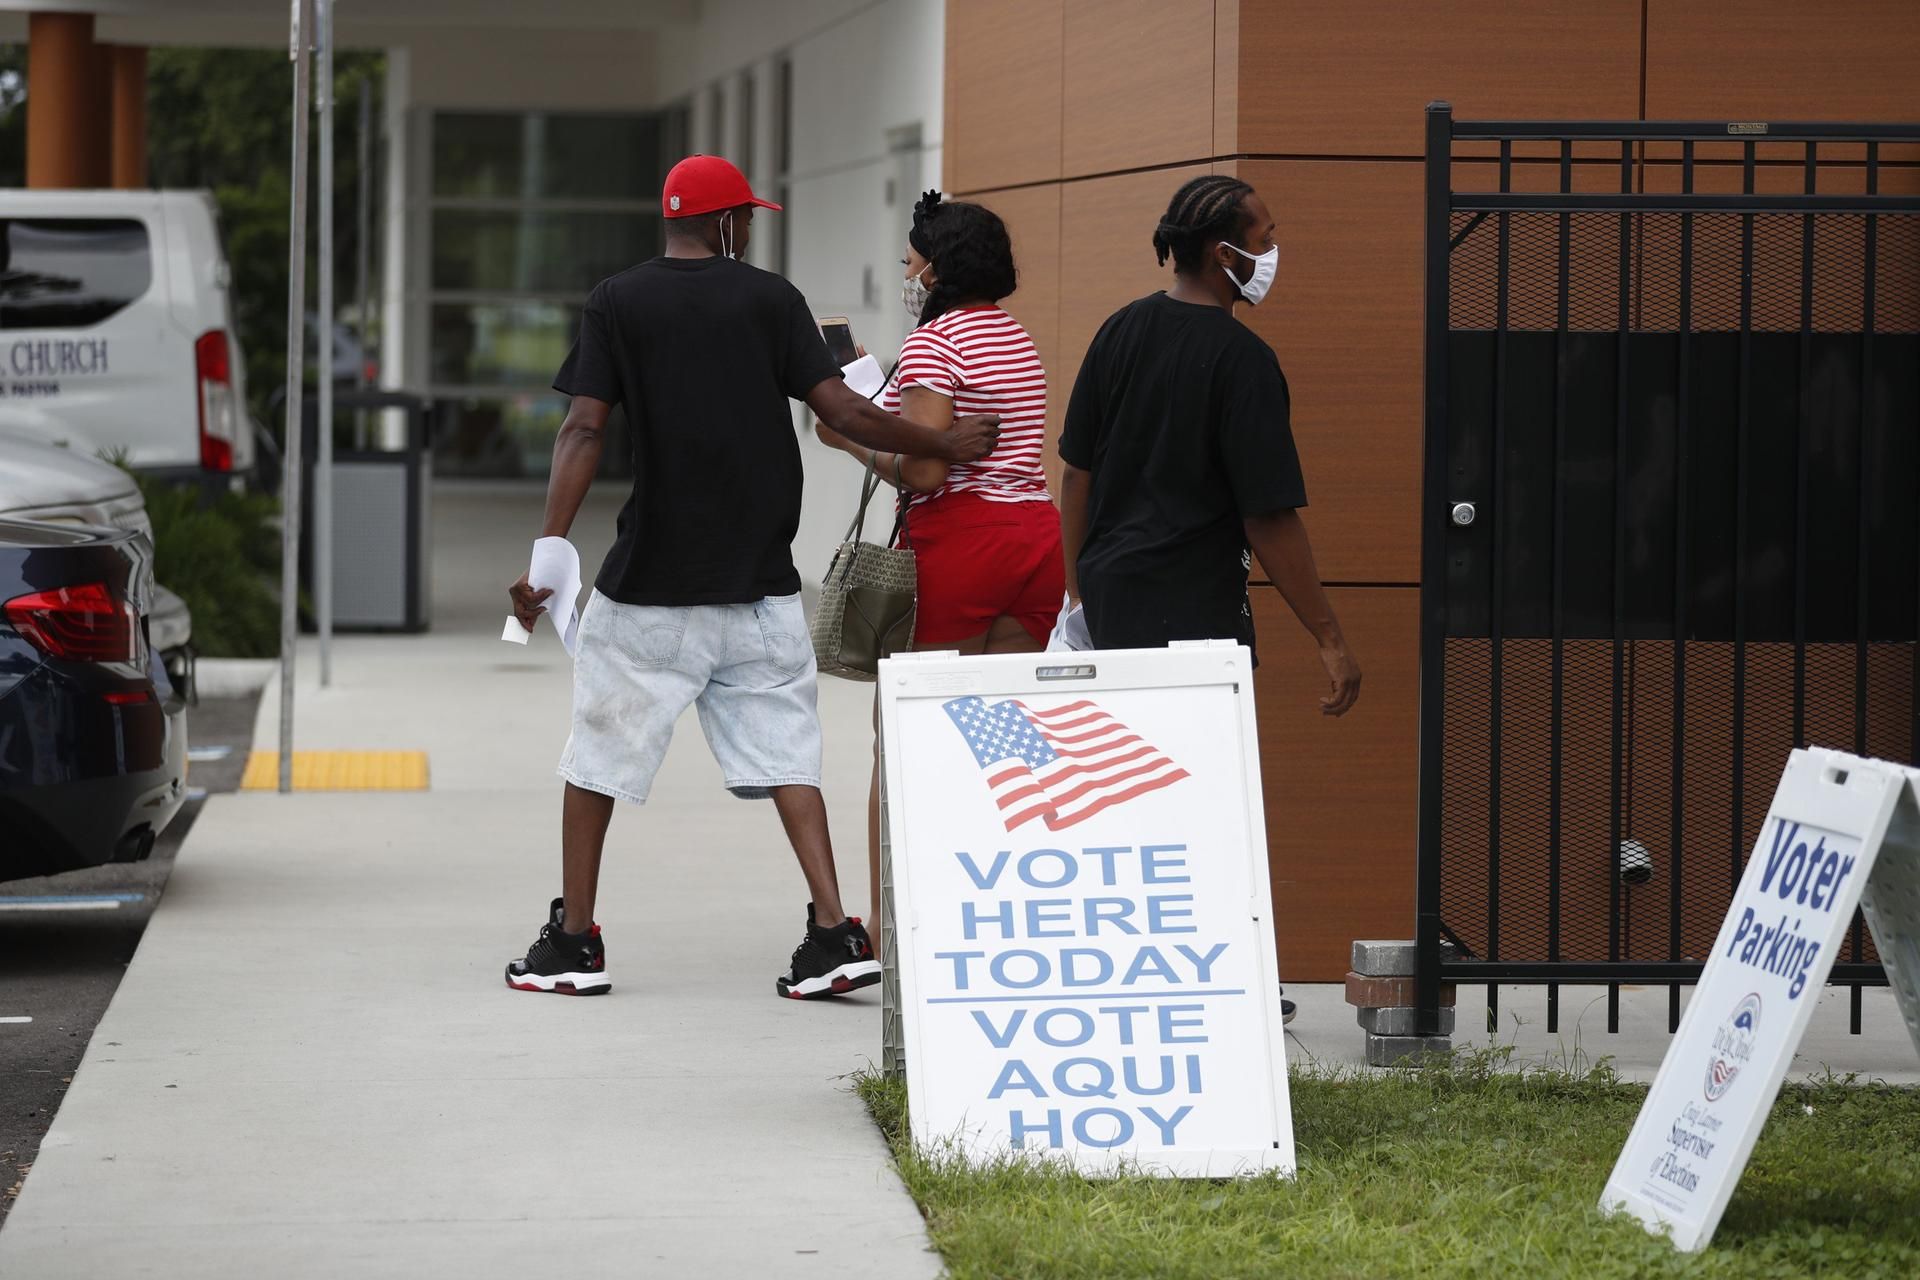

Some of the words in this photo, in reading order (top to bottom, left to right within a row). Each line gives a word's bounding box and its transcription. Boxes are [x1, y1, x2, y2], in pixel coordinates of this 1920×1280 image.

[10, 338, 107, 376] CHURCH
[955, 844, 1191, 889] VOTE
[1760, 820, 1856, 913] Voter
[961, 895, 1198, 940] HERE
[934, 943, 1230, 989] TODAY
[1727, 907, 1821, 1000] Parking
[971, 1004, 1208, 1049] VOTE
[987, 1055, 1202, 1100] AQUI
[1009, 1106, 1193, 1149] HOY
[1666, 1118, 1715, 1160] Supervisor
